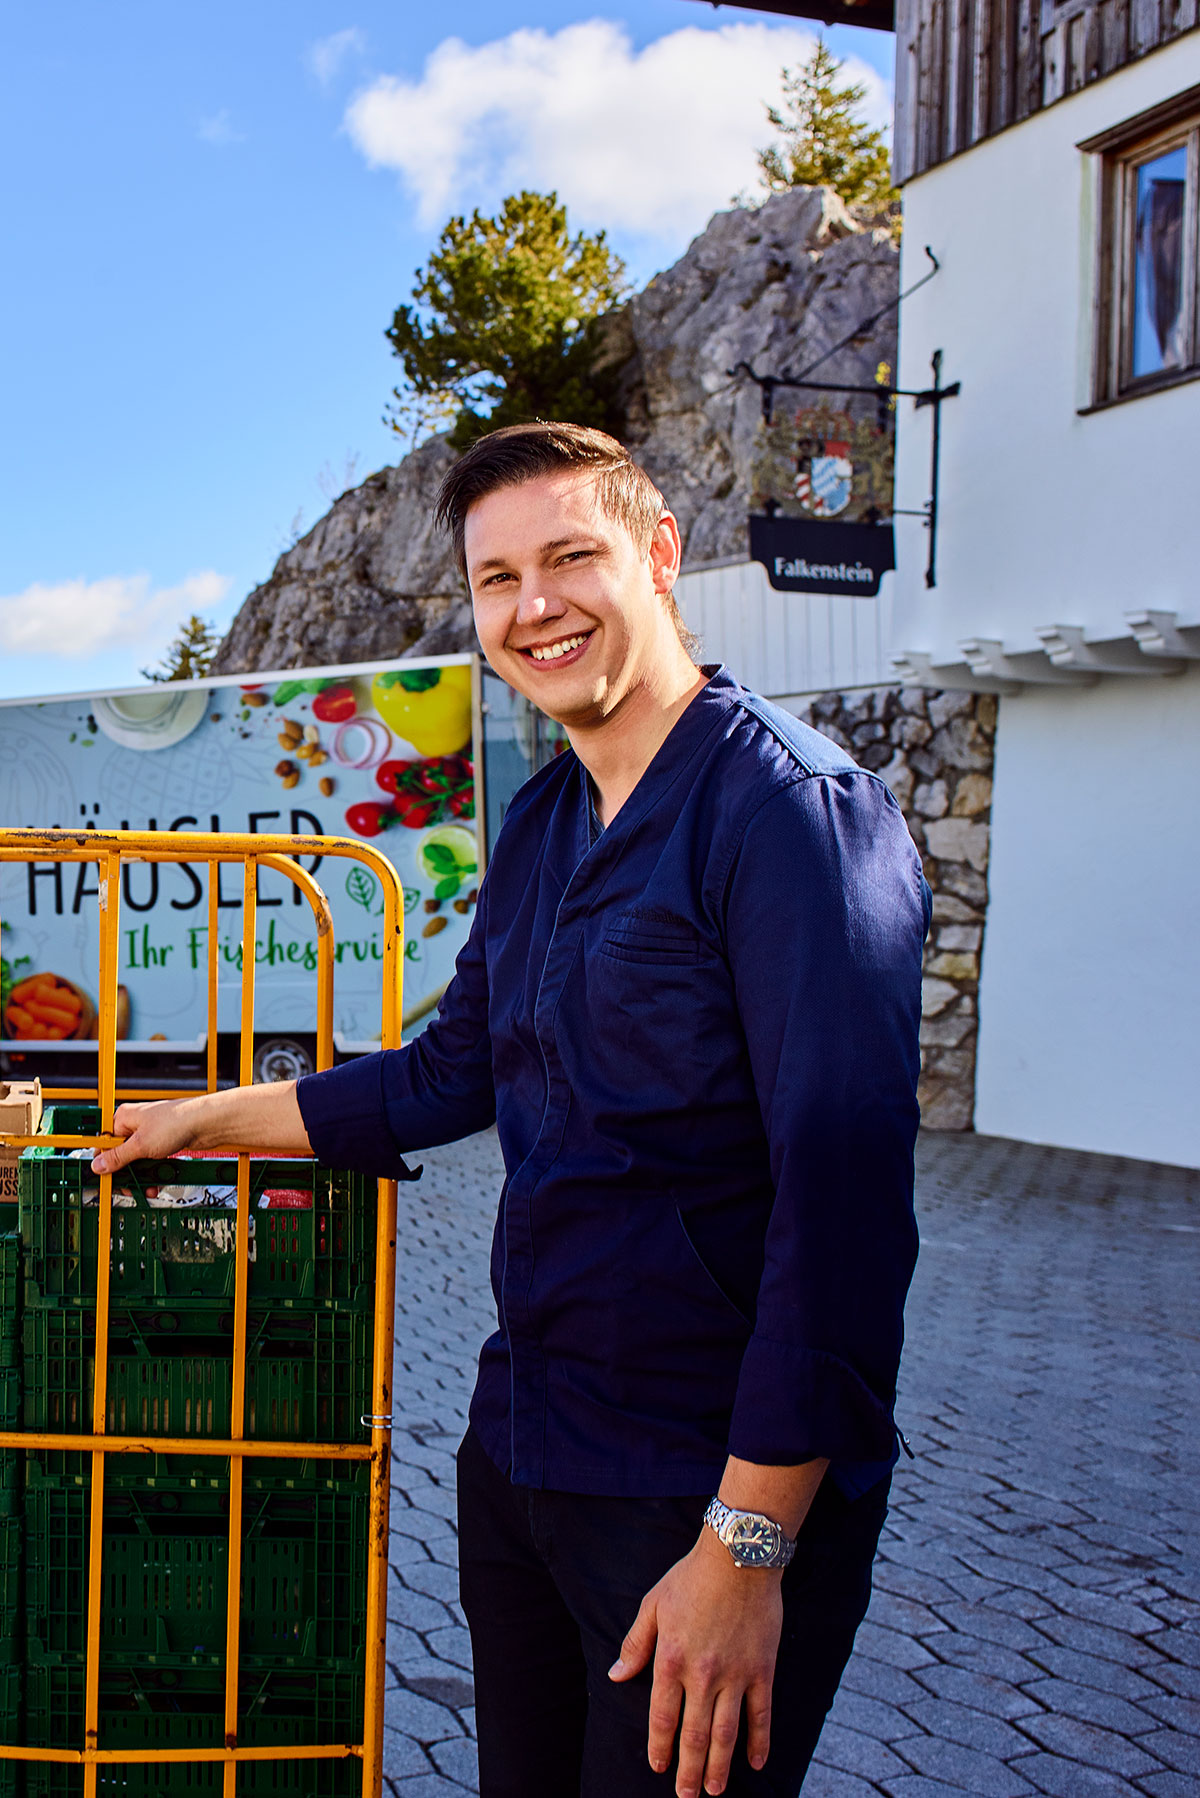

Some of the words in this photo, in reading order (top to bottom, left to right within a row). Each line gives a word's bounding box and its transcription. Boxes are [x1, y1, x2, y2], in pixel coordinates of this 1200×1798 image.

[774, 557, 874, 583] Falkenstein
[26, 803, 329, 915] HÄUSLER
[124, 923, 174, 969] Ihr
[187, 918, 422, 971] Fischesrvie
